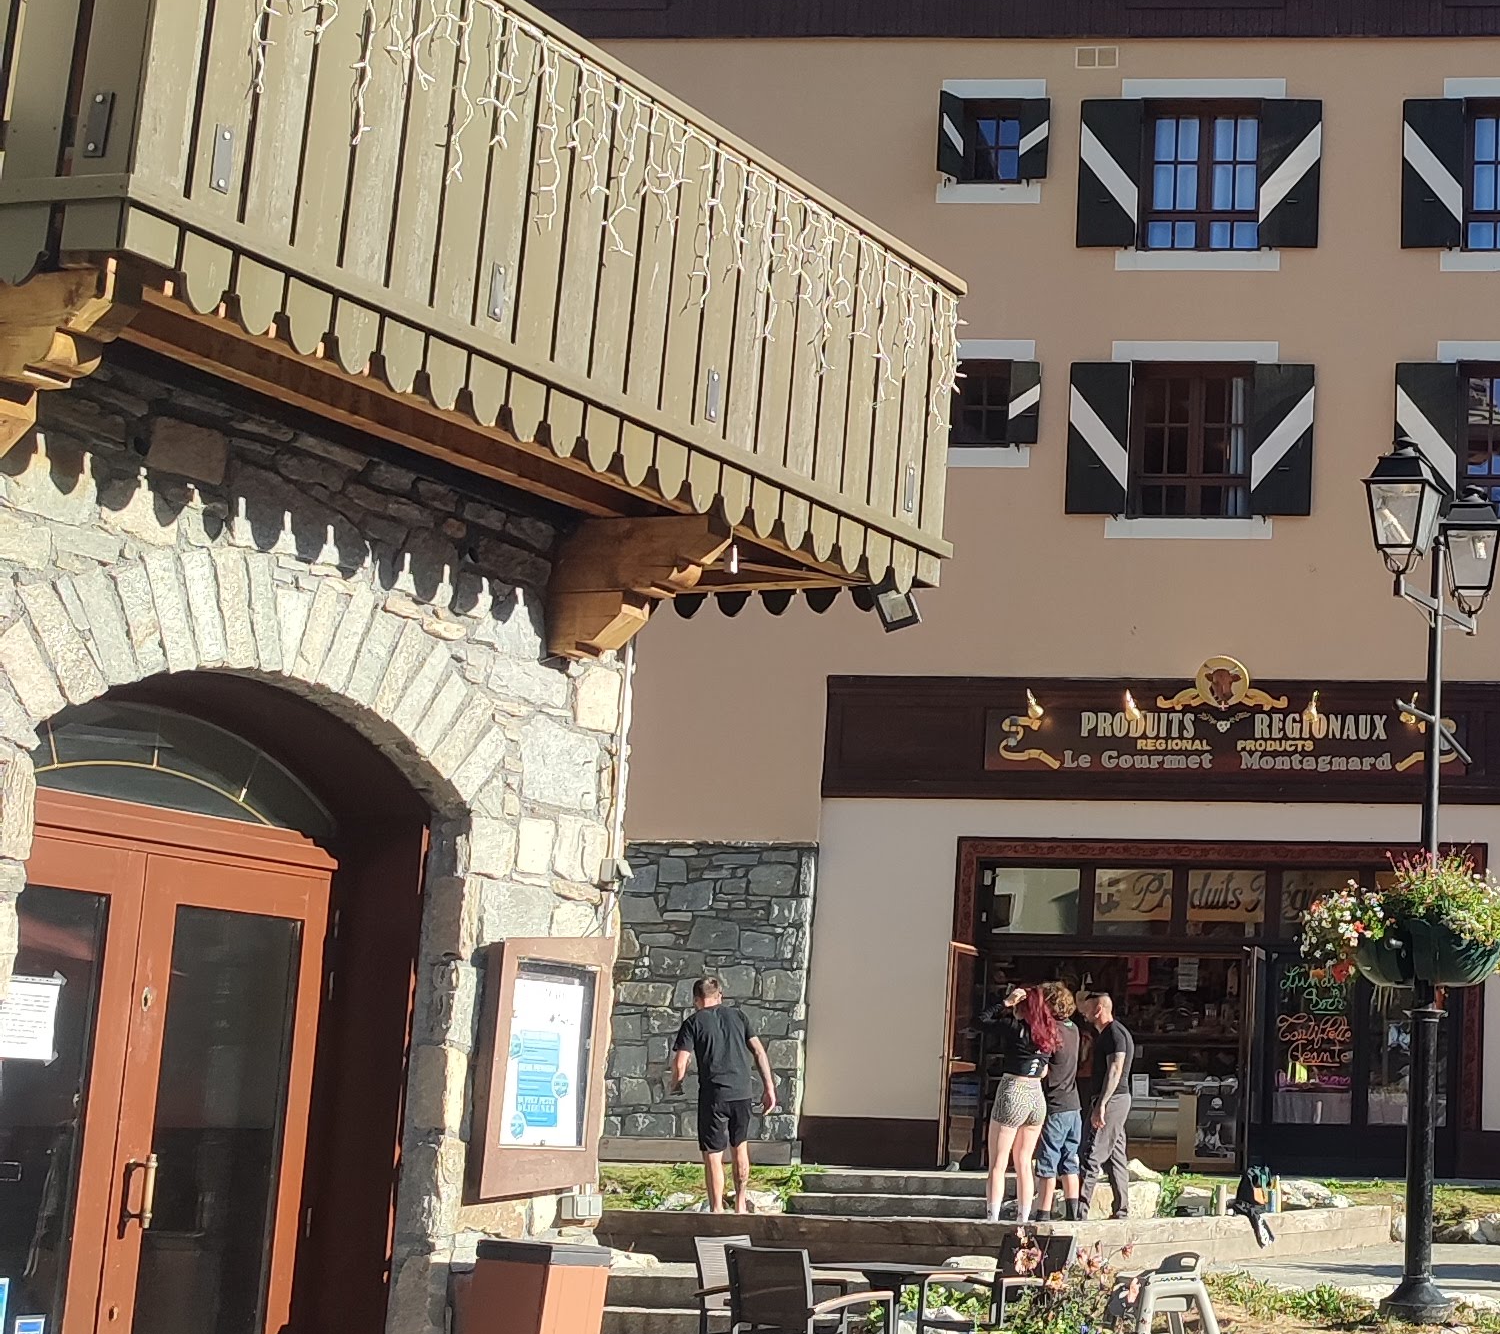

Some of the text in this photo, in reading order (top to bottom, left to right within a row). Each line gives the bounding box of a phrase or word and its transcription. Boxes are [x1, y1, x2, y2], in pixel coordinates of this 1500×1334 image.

[1080, 711, 1388, 740] PRODUITS REGIONAUX
[1137, 739, 1314, 752] REGIONAL PRODUCTS
[1063, 749, 1392, 772] Le Gourmet Montagnard
